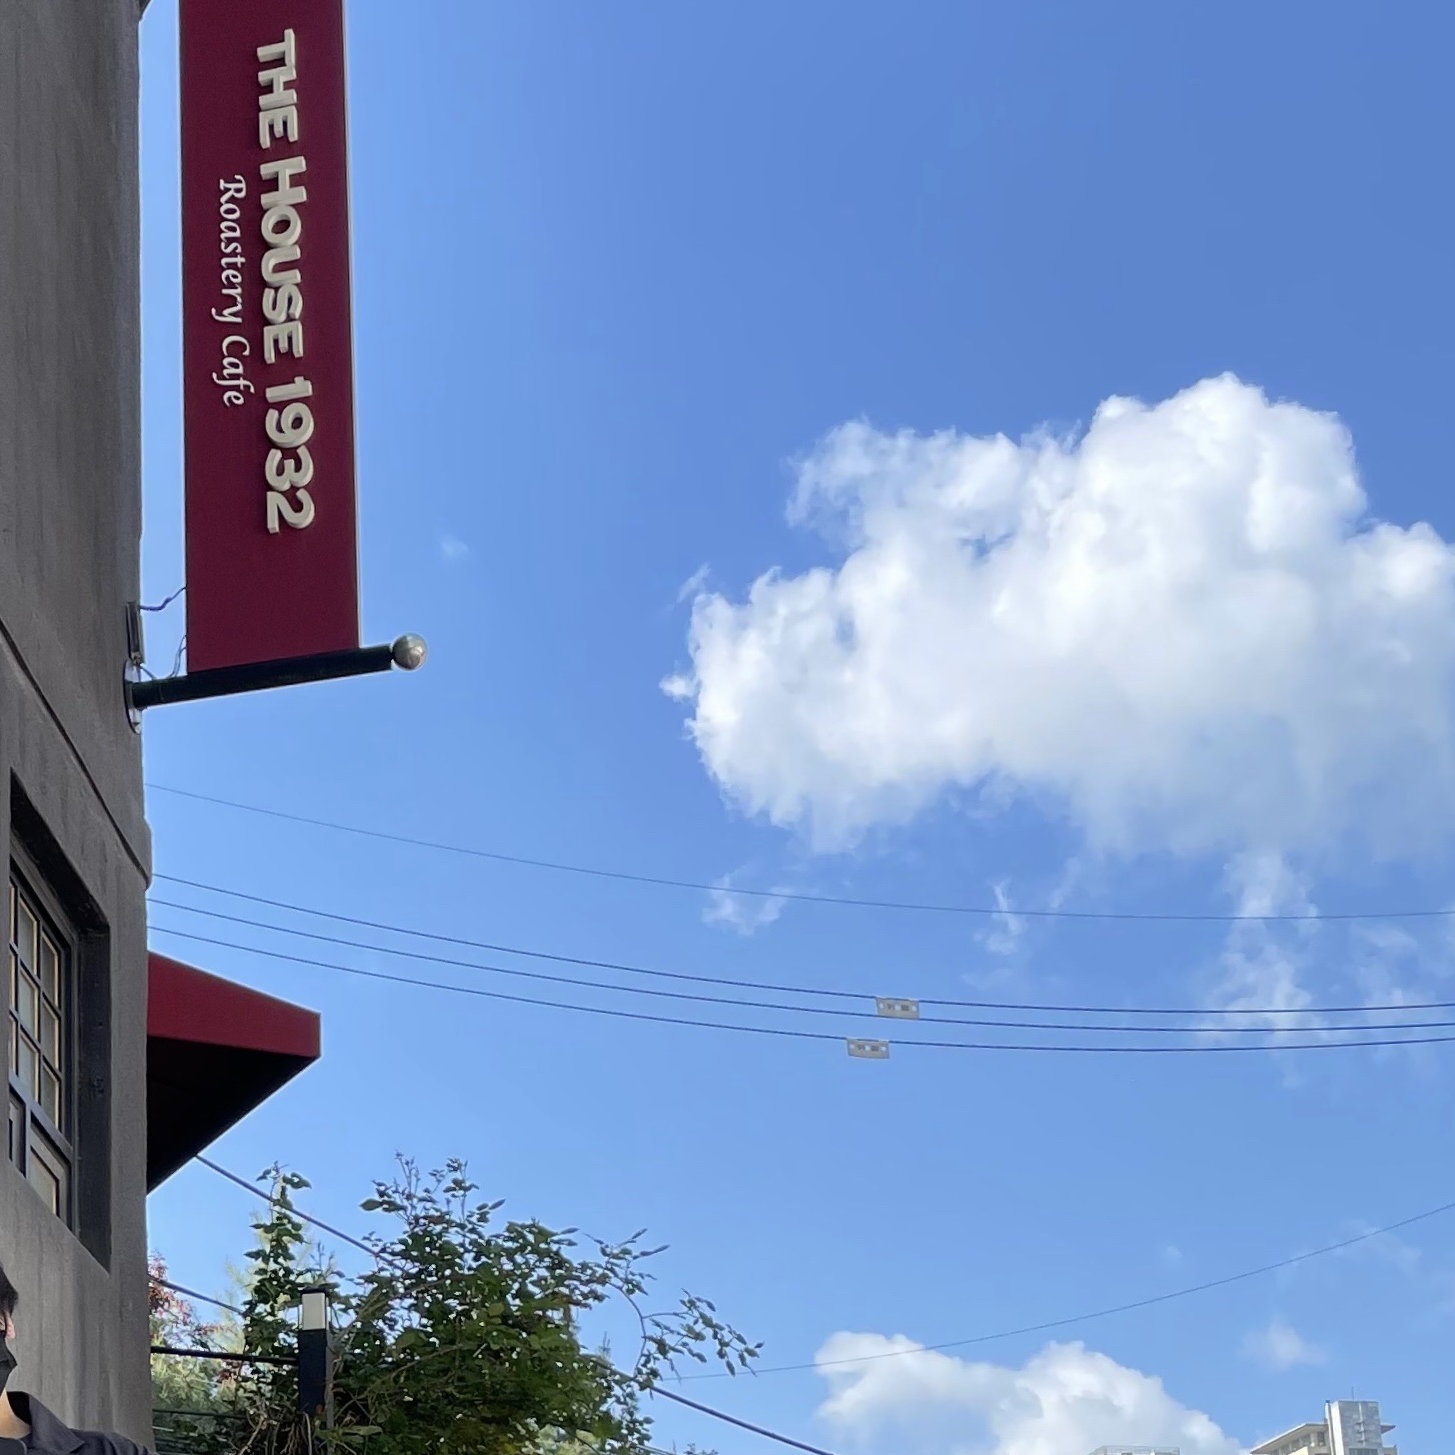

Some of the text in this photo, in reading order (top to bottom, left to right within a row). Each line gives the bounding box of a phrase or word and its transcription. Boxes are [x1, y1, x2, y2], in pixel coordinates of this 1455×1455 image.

[211, 173, 254, 408] Roastery Cafe
[256, 28, 316, 535] THE HOUSE 1932
